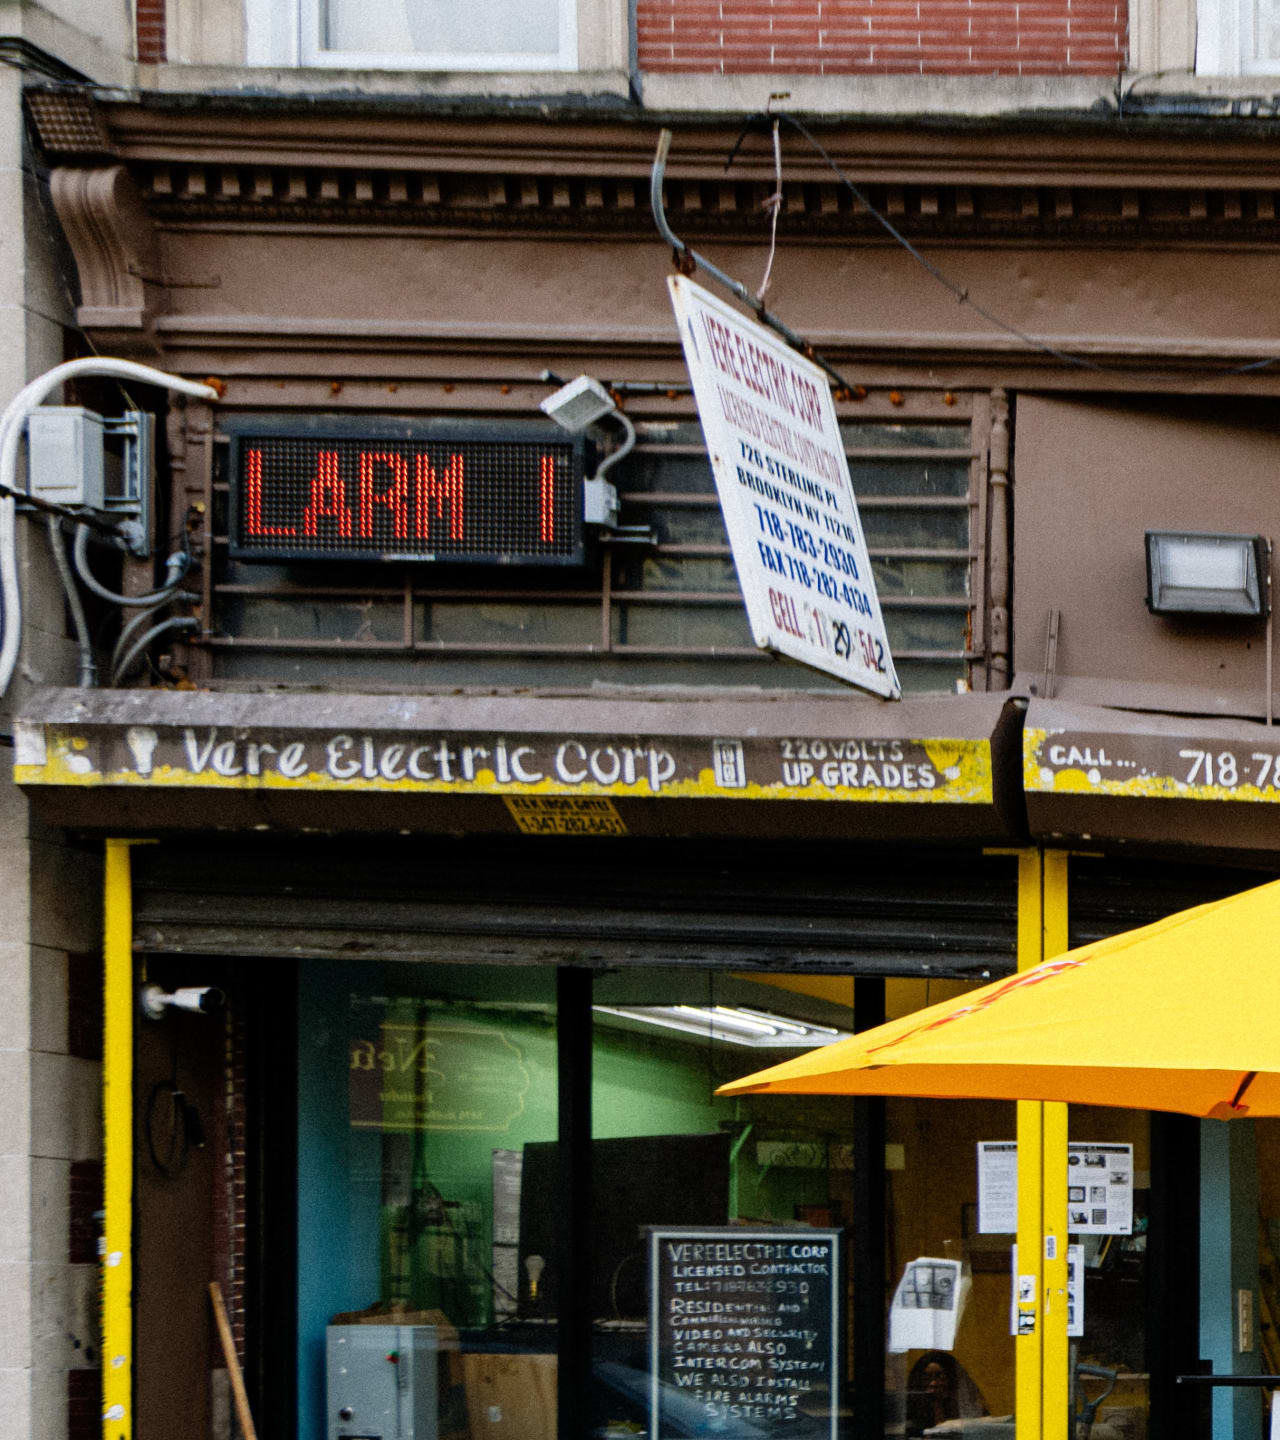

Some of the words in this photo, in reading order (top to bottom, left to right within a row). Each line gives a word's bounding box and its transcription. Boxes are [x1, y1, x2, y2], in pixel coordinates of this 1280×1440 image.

[764, 454, 824, 503] STERLING
[736, 466, 803, 517] BROOKLYN
[804, 503, 821, 526] NY
[754, 503, 859, 580] 718-783-2930
[757, 539, 786, 576] FAX
[784, 552, 872, 618] 718-282-4134
[183, 727, 308, 778] Vere
[326, 735, 544, 784] Electric
[555, 739, 676, 791] Corp
[781, 739, 827, 760] 220
[831, 740, 904, 761] VOLTS
[781, 762, 814, 786] UP
[821, 763, 936, 789] GRADES
[672, 1264, 746, 1278] LICENSED
[672, 1329, 723, 1341] VIDEO
[747, 1340, 787, 1356] ALSO
[672, 1356, 762, 1370] INTERCOM
[673, 1372, 704, 1387] WE
[710, 1373, 750, 1388] ALSO
[736, 1391, 799, 1407] ALARMS
